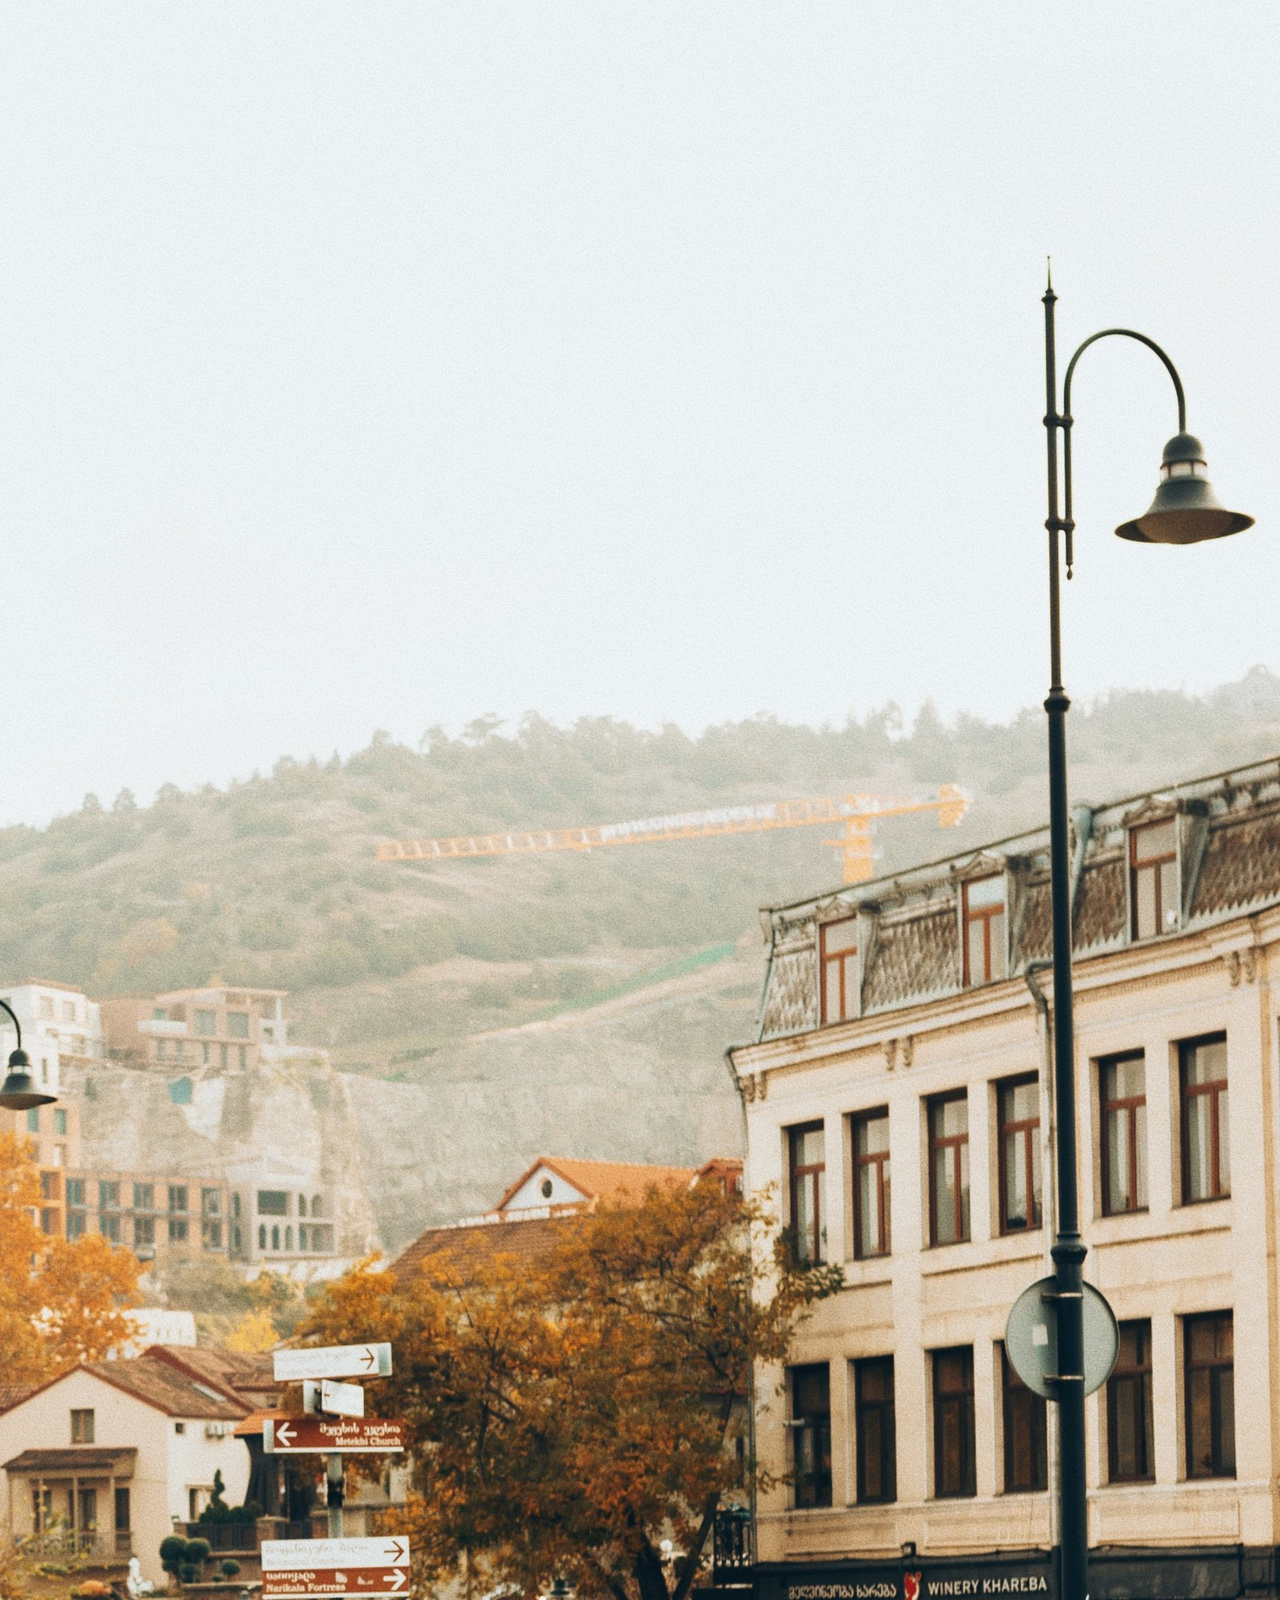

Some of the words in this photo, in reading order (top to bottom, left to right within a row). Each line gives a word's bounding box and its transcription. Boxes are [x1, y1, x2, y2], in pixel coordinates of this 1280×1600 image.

[336, 1436, 368, 1446] Metekhi
[370, 1436, 401, 1446] Church
[266, 1583, 305, 1593] Narikala
[308, 1583, 346, 1593] Fortress
[928, 1578, 979, 1596] WINERY
[983, 1576, 1047, 1594] KHAREBA
